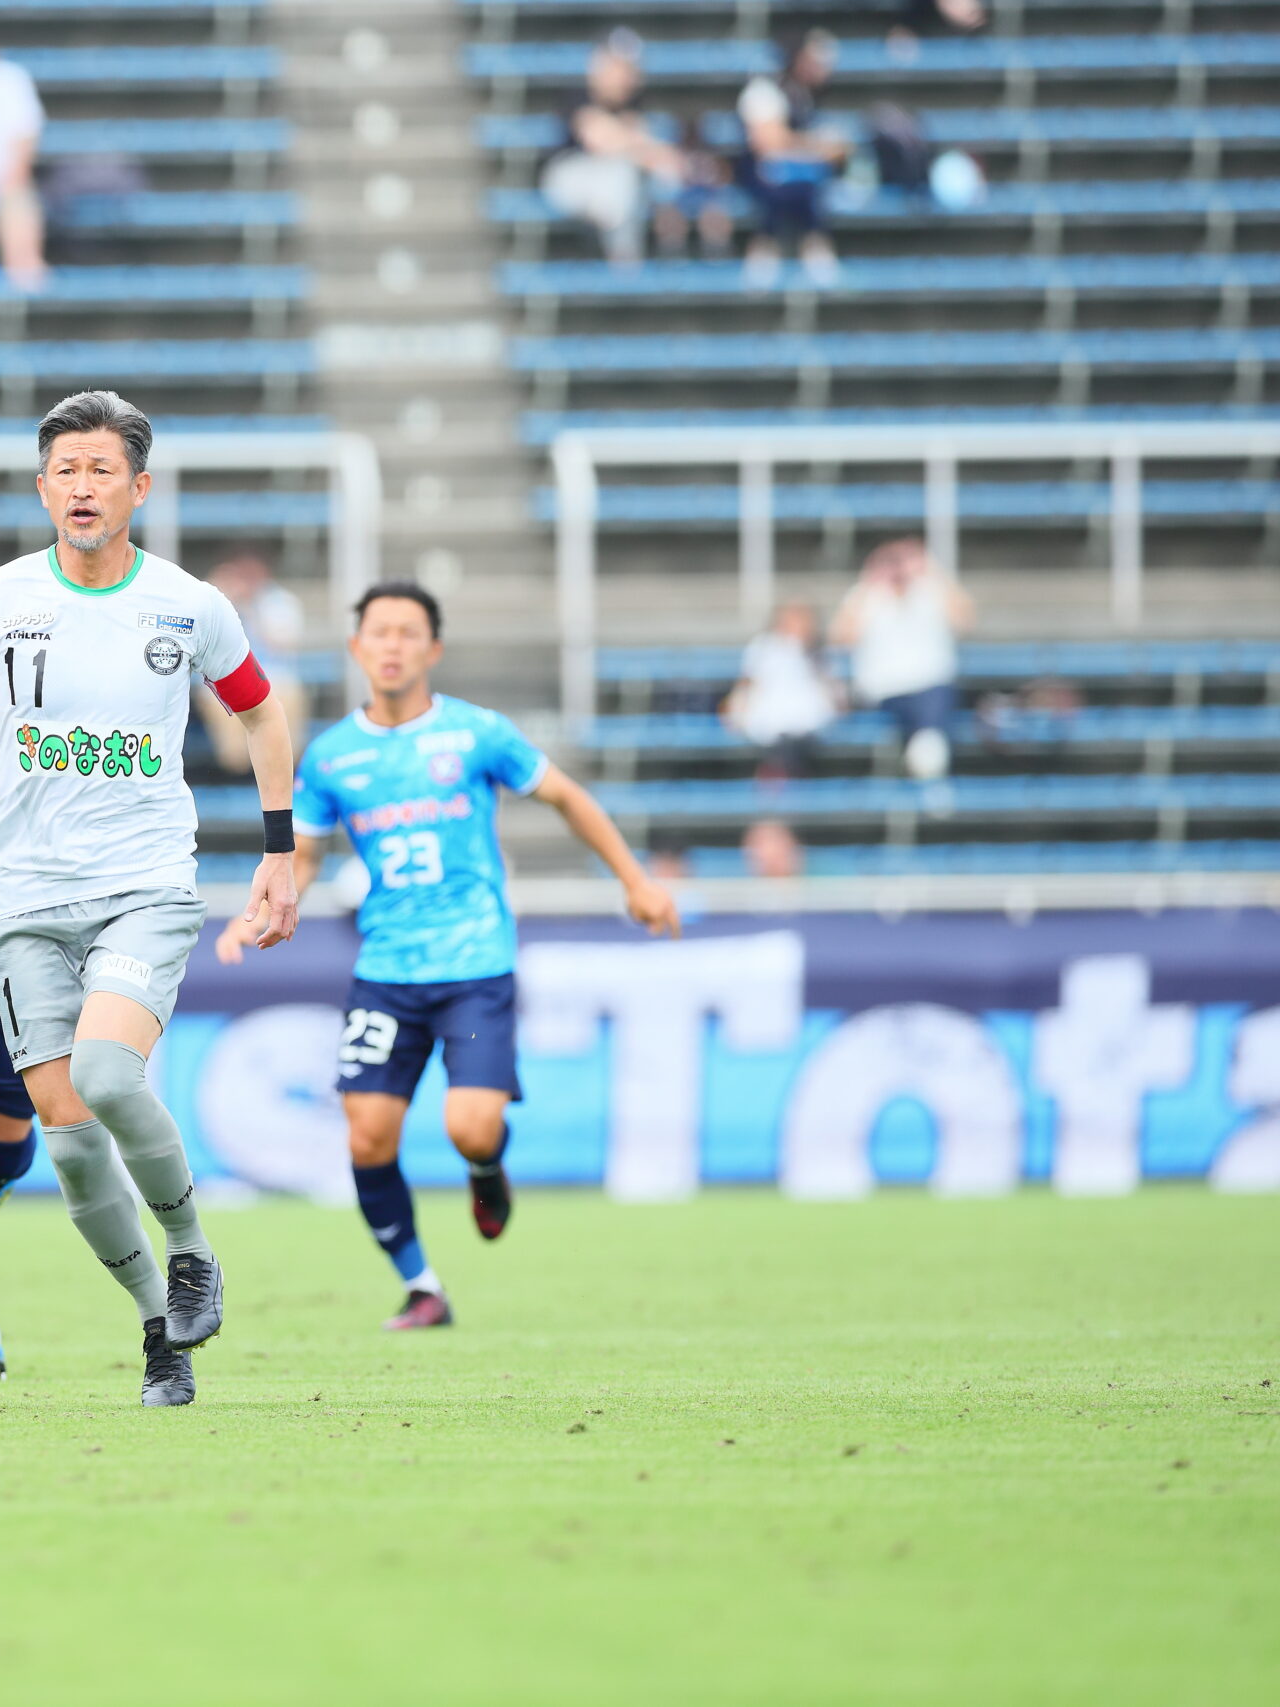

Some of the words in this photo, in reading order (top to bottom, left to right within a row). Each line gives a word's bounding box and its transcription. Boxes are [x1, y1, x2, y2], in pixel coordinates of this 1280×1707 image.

[5, 629, 51, 641] ATHLETA
[160, 616, 193, 626] FUDEAL
[4, 647, 47, 708] 11
[378, 831, 444, 889] 23
[339, 1008, 399, 1065] 23
